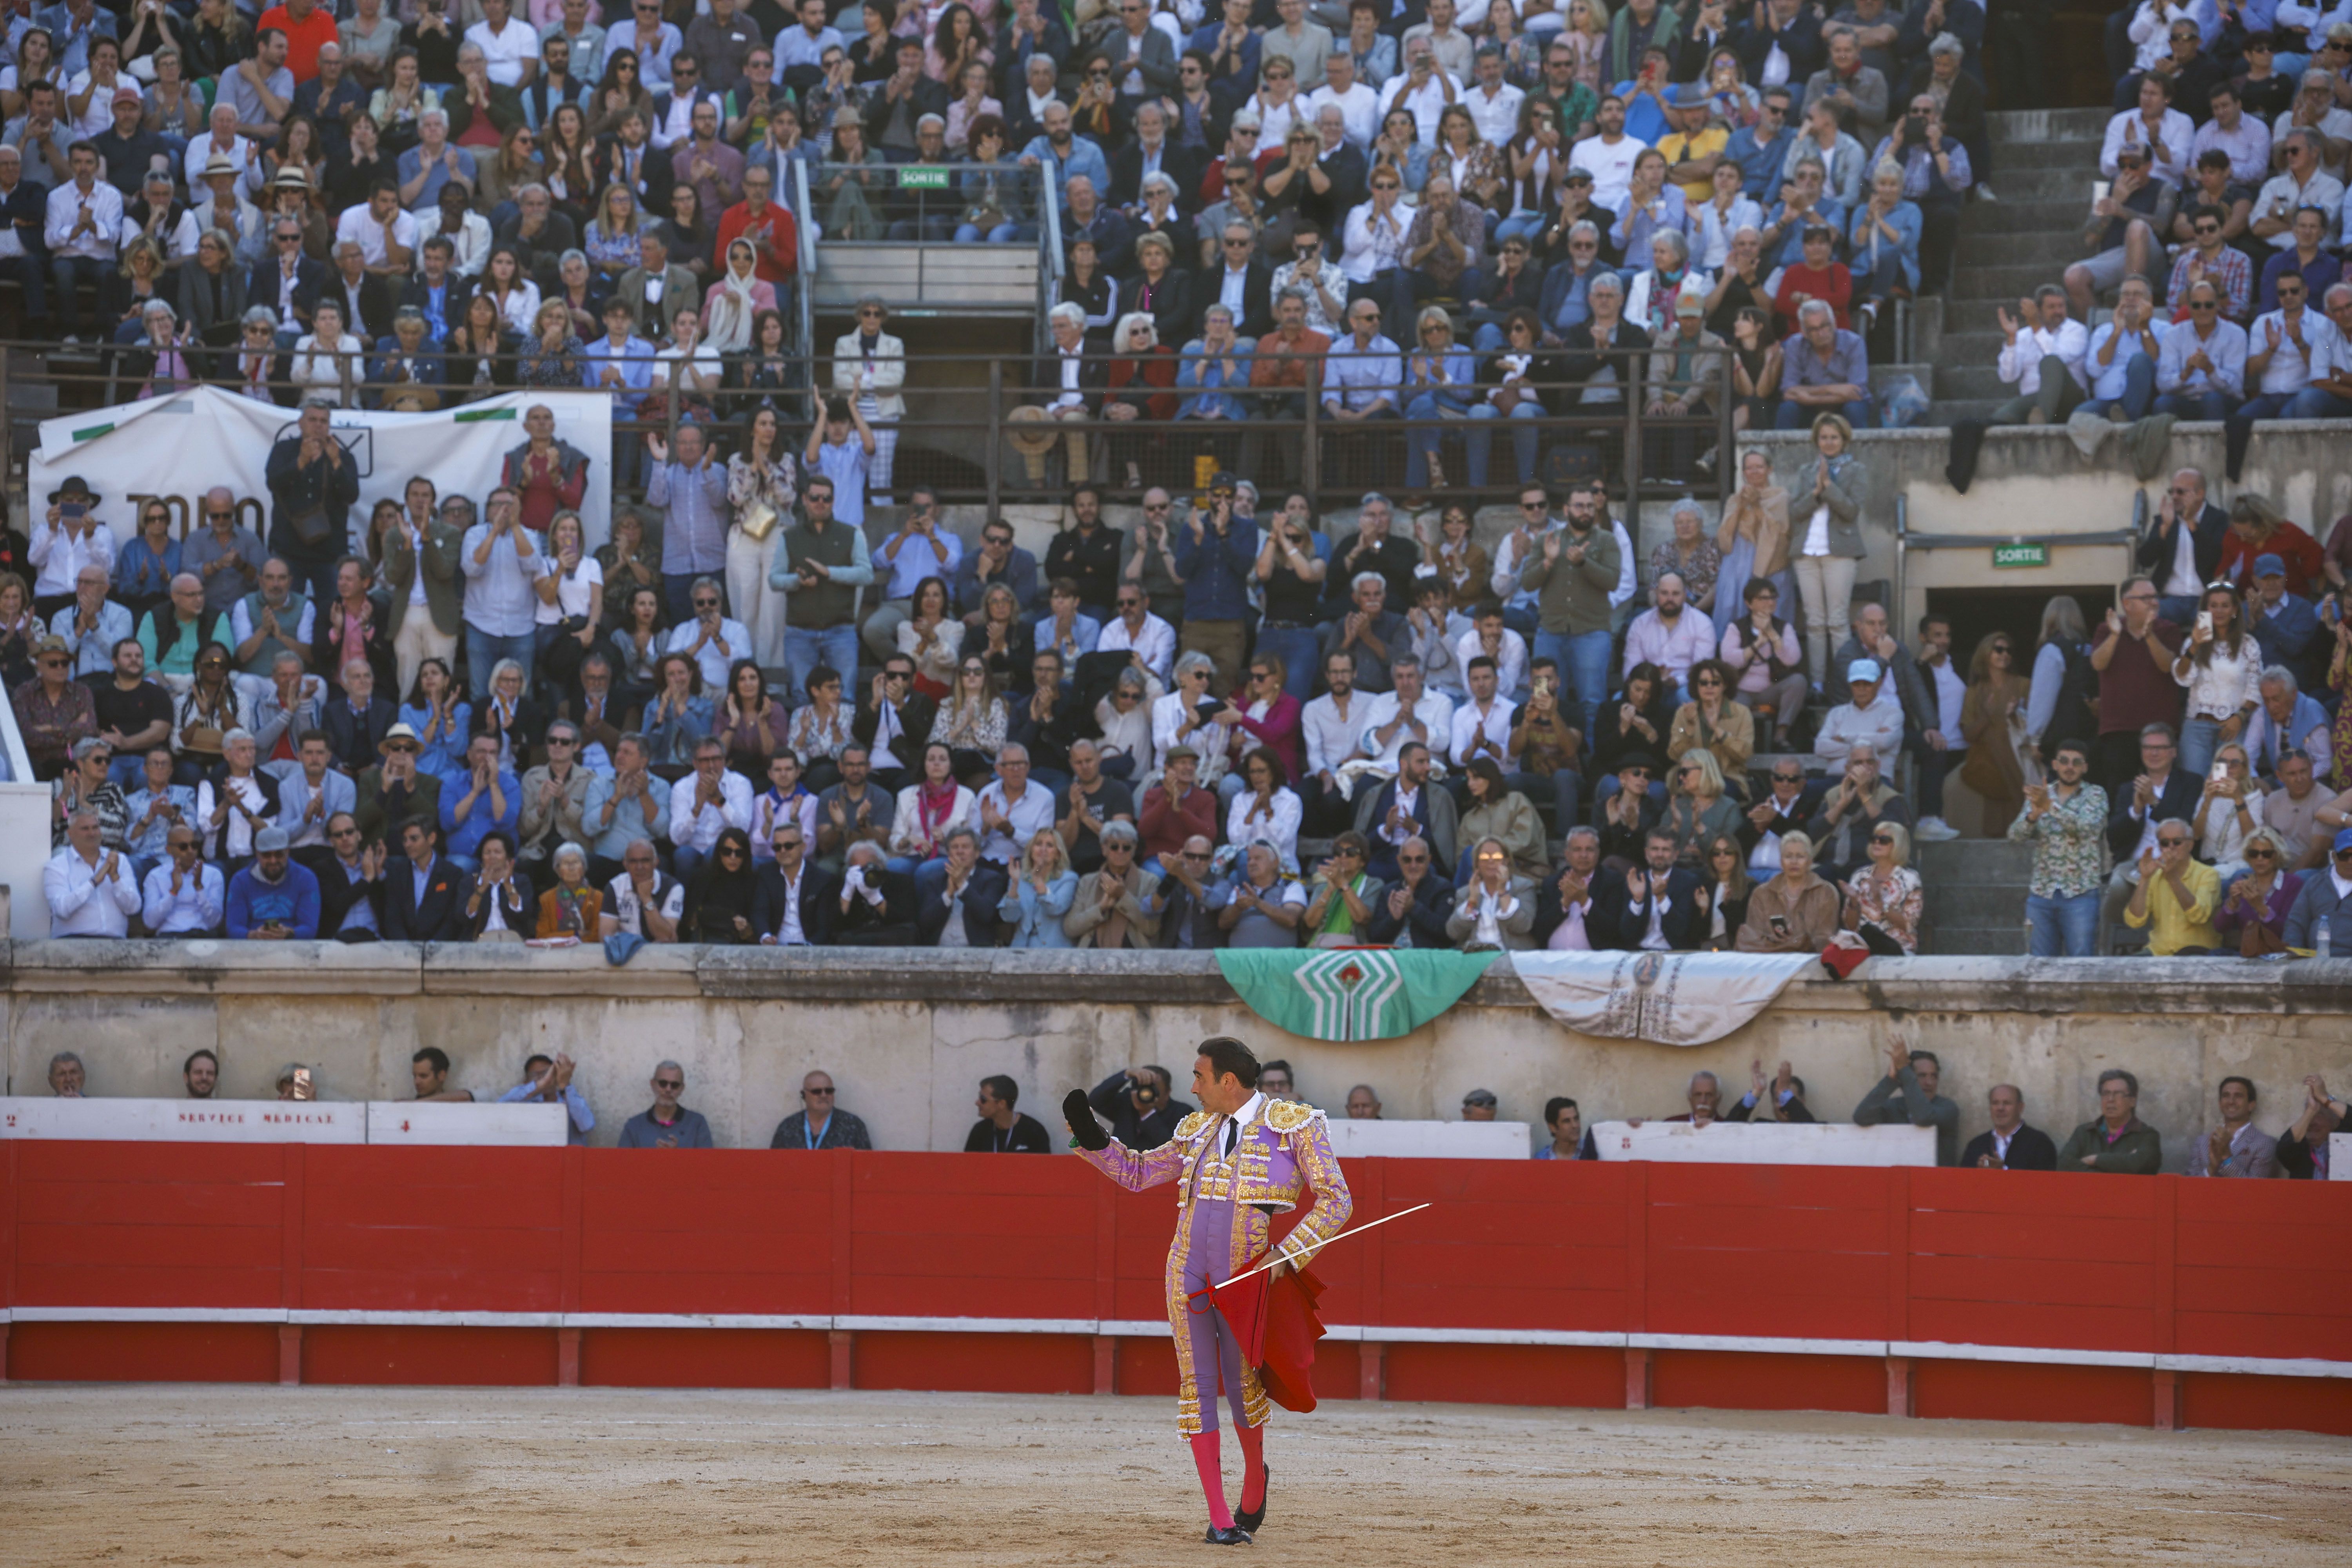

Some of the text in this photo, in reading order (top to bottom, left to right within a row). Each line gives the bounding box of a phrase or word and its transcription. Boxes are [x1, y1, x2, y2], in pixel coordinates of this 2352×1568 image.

[902, 171, 945, 184] SORTIE
[1996, 548, 2043, 563] SORTIE
[6, 1114, 16, 1127] 2
[179, 1113, 335, 1123] SERVICE MEDICAL
[400, 1120, 410, 1132] 4
